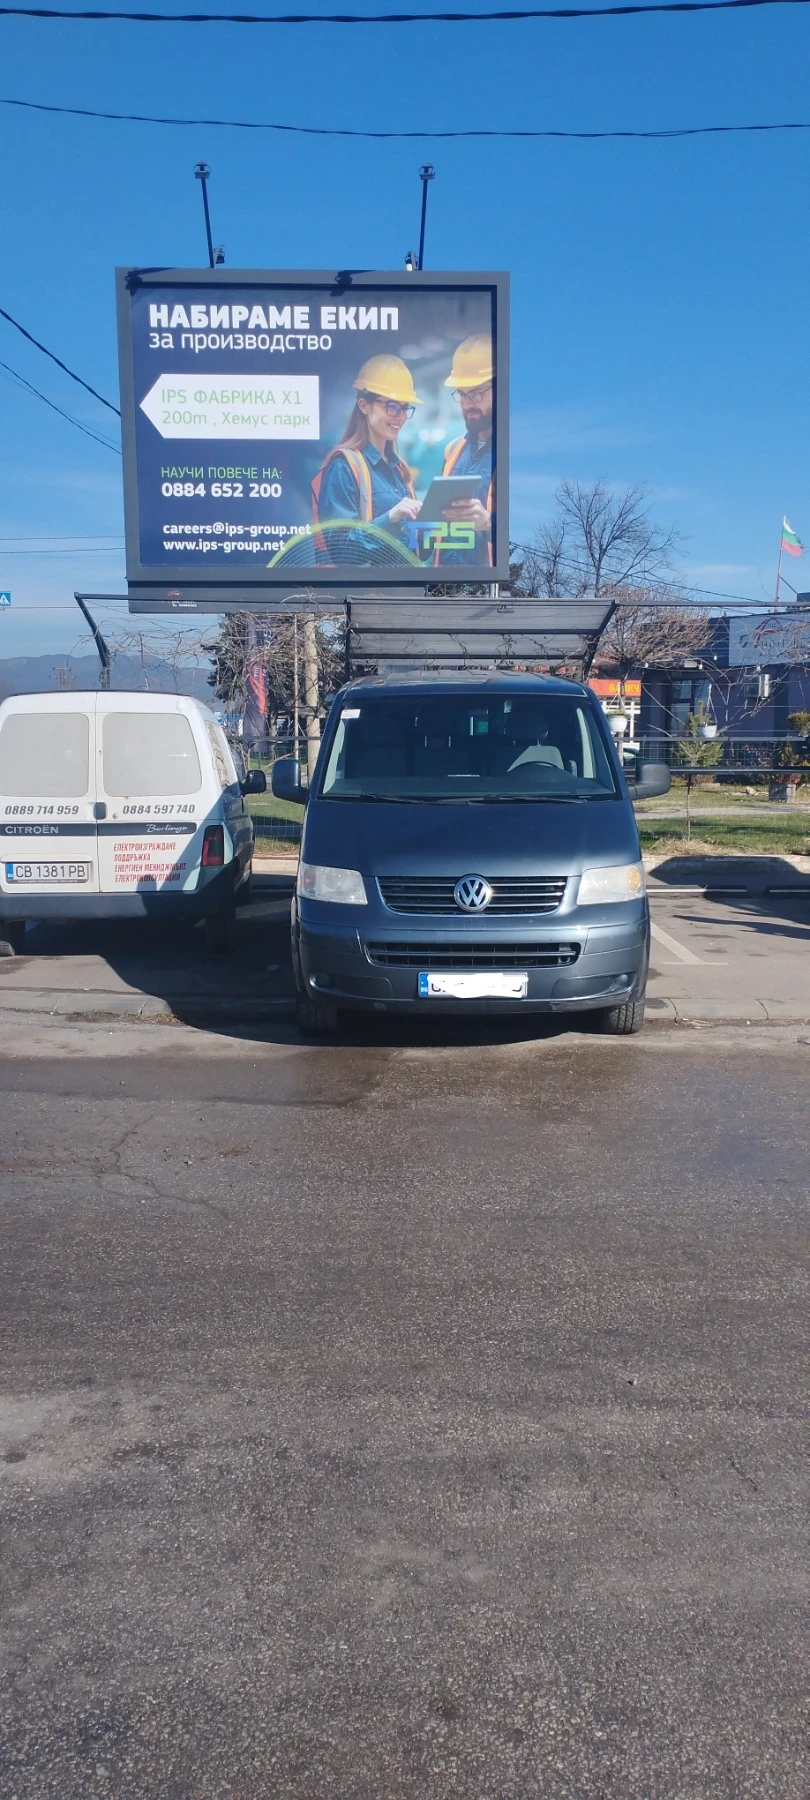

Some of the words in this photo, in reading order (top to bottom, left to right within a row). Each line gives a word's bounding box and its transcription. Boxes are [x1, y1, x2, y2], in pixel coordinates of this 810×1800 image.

[149, 304, 310, 330] НАБИРАМЕ
[320, 306, 399, 331] ЕКИП
[149, 333, 174, 349] за
[181, 333, 332, 353] производство
[161, 389, 187, 404] IPS
[193, 389, 276, 405] ФАБРИКА
[221, 412, 269, 429] Хемус
[273, 414, 311, 429] парк
[161, 466, 204, 479] НАУЧИ
[208, 467, 258, 479] ПОВЕЧЕ
[262, 467, 283, 480] НА:
[161, 482, 206, 497] 0884
[211, 482, 244, 498] 652
[249, 483, 282, 498] 200
[162, 521, 312, 537] careers@ips-group.net
[162, 538, 286, 553] www.ips-group.net
[4, 805, 34, 815] 0889
[36, 805, 54, 815] 714
[57, 804, 79, 815] 959
[122, 805, 151, 815] 0884
[153, 804, 174, 814] 597
[176, 804, 196, 814] 740
[4, 824, 59, 834] CITROËN
[145, 823, 188, 833] Berlingo
[113, 842, 177, 852] ЕЛЕКТРОИЗГРАЖДАНЕ
[113, 853, 151, 862] ПОДДРЪЖКА
[36, 865, 65, 878] 1381
[114, 864, 143, 873] ЕНЕРГИЕН
